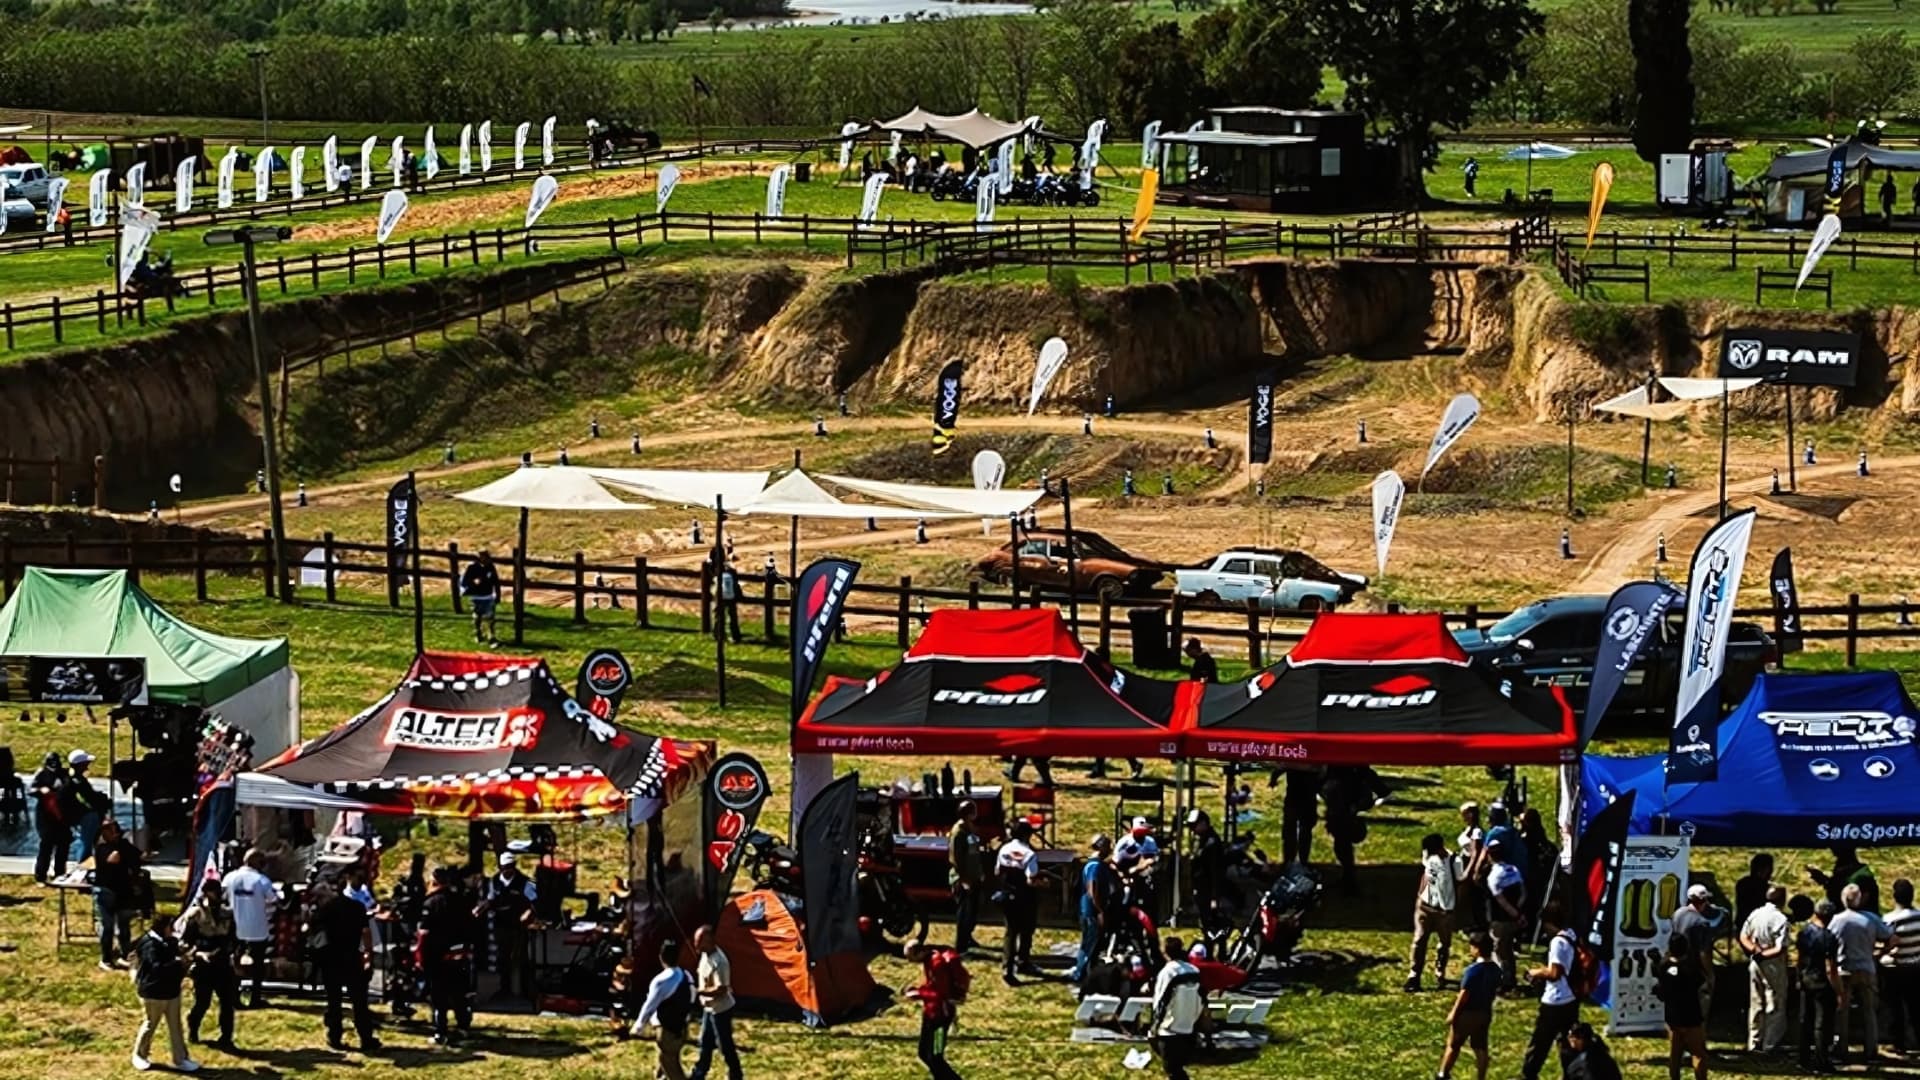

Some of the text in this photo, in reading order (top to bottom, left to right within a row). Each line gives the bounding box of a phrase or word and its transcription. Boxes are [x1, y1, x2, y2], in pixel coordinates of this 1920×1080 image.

[1766, 348, 1850, 365] RAM
[942, 378, 958, 420] VOGE
[1256, 385, 1270, 427] VOGE
[394, 499, 408, 546] VOGE
[395, 711, 501, 738] ALTER
